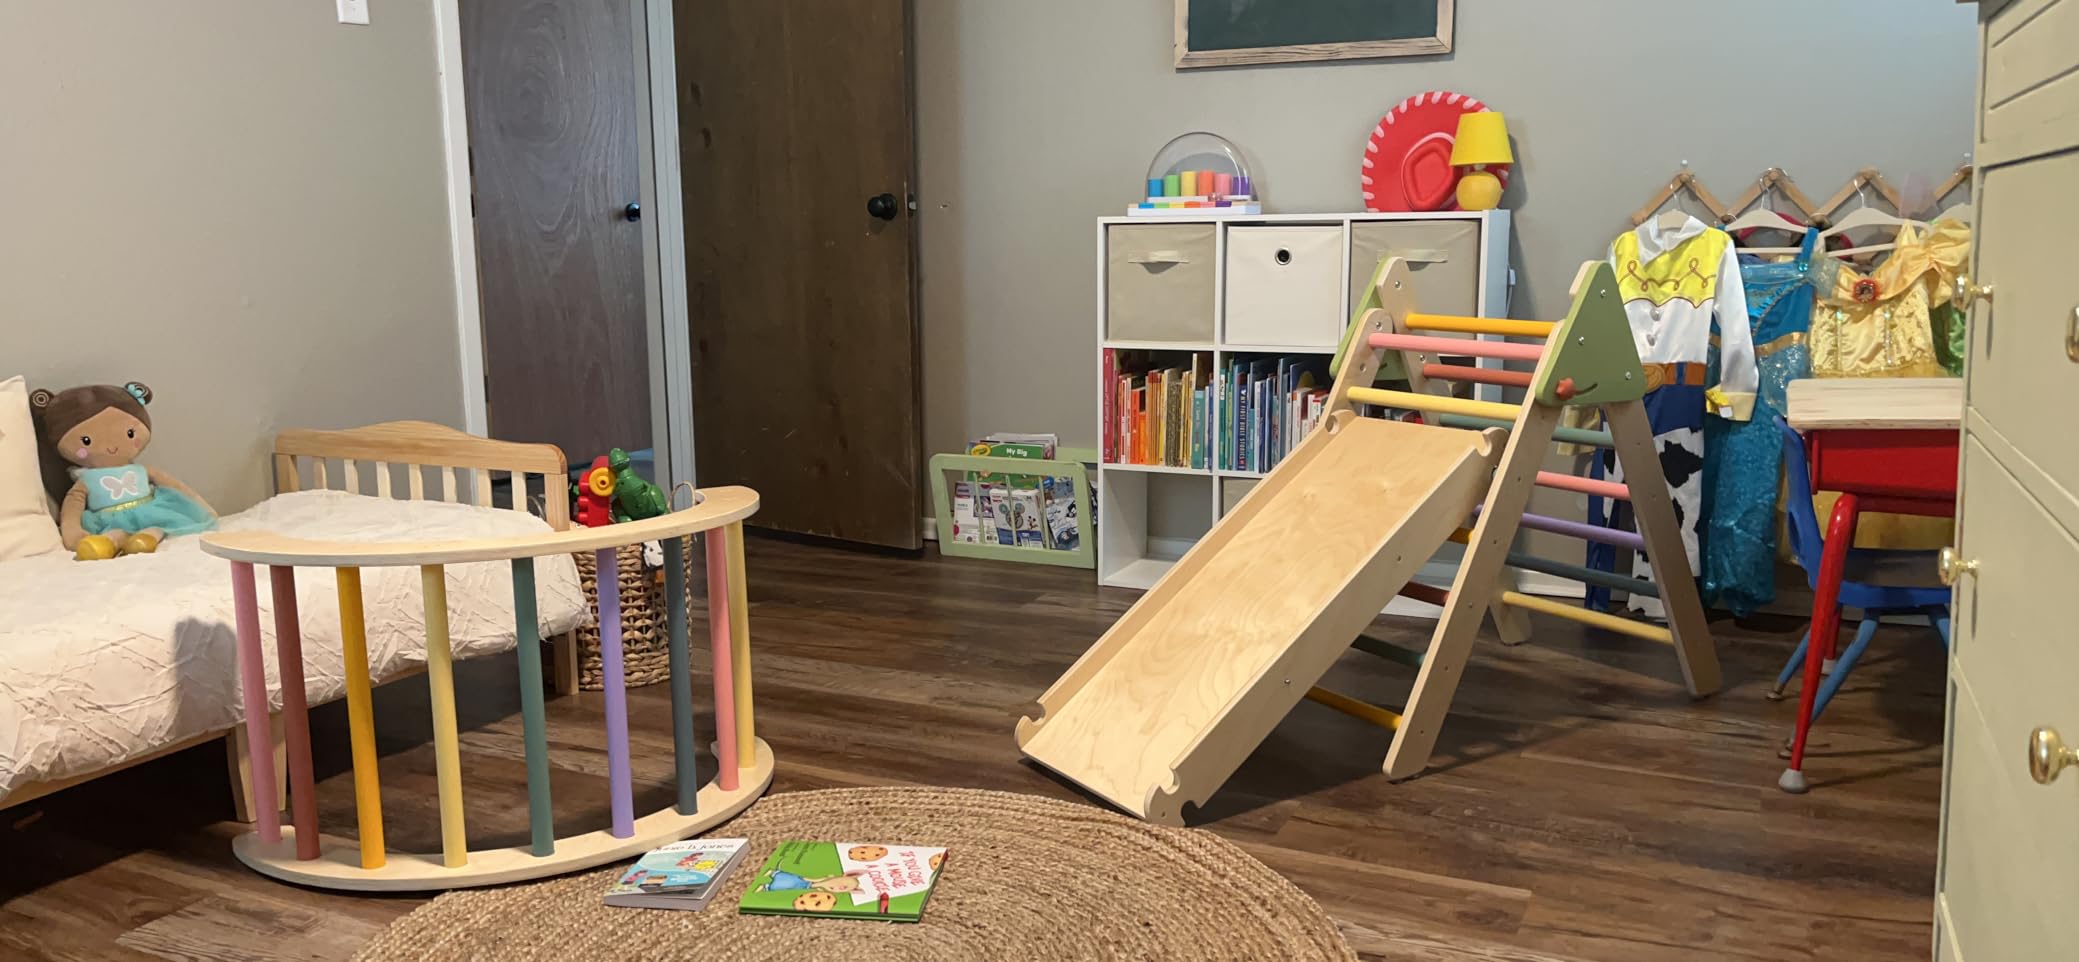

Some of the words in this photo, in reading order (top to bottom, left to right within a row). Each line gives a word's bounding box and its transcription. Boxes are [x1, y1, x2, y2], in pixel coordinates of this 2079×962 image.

[1006, 447, 1016, 456] My
[1016, 448, 1028, 457] Big
[903, 858, 921, 870] YOU
[888, 868, 906, 888] MOUSE
[908, 871, 925, 885] GIVE
